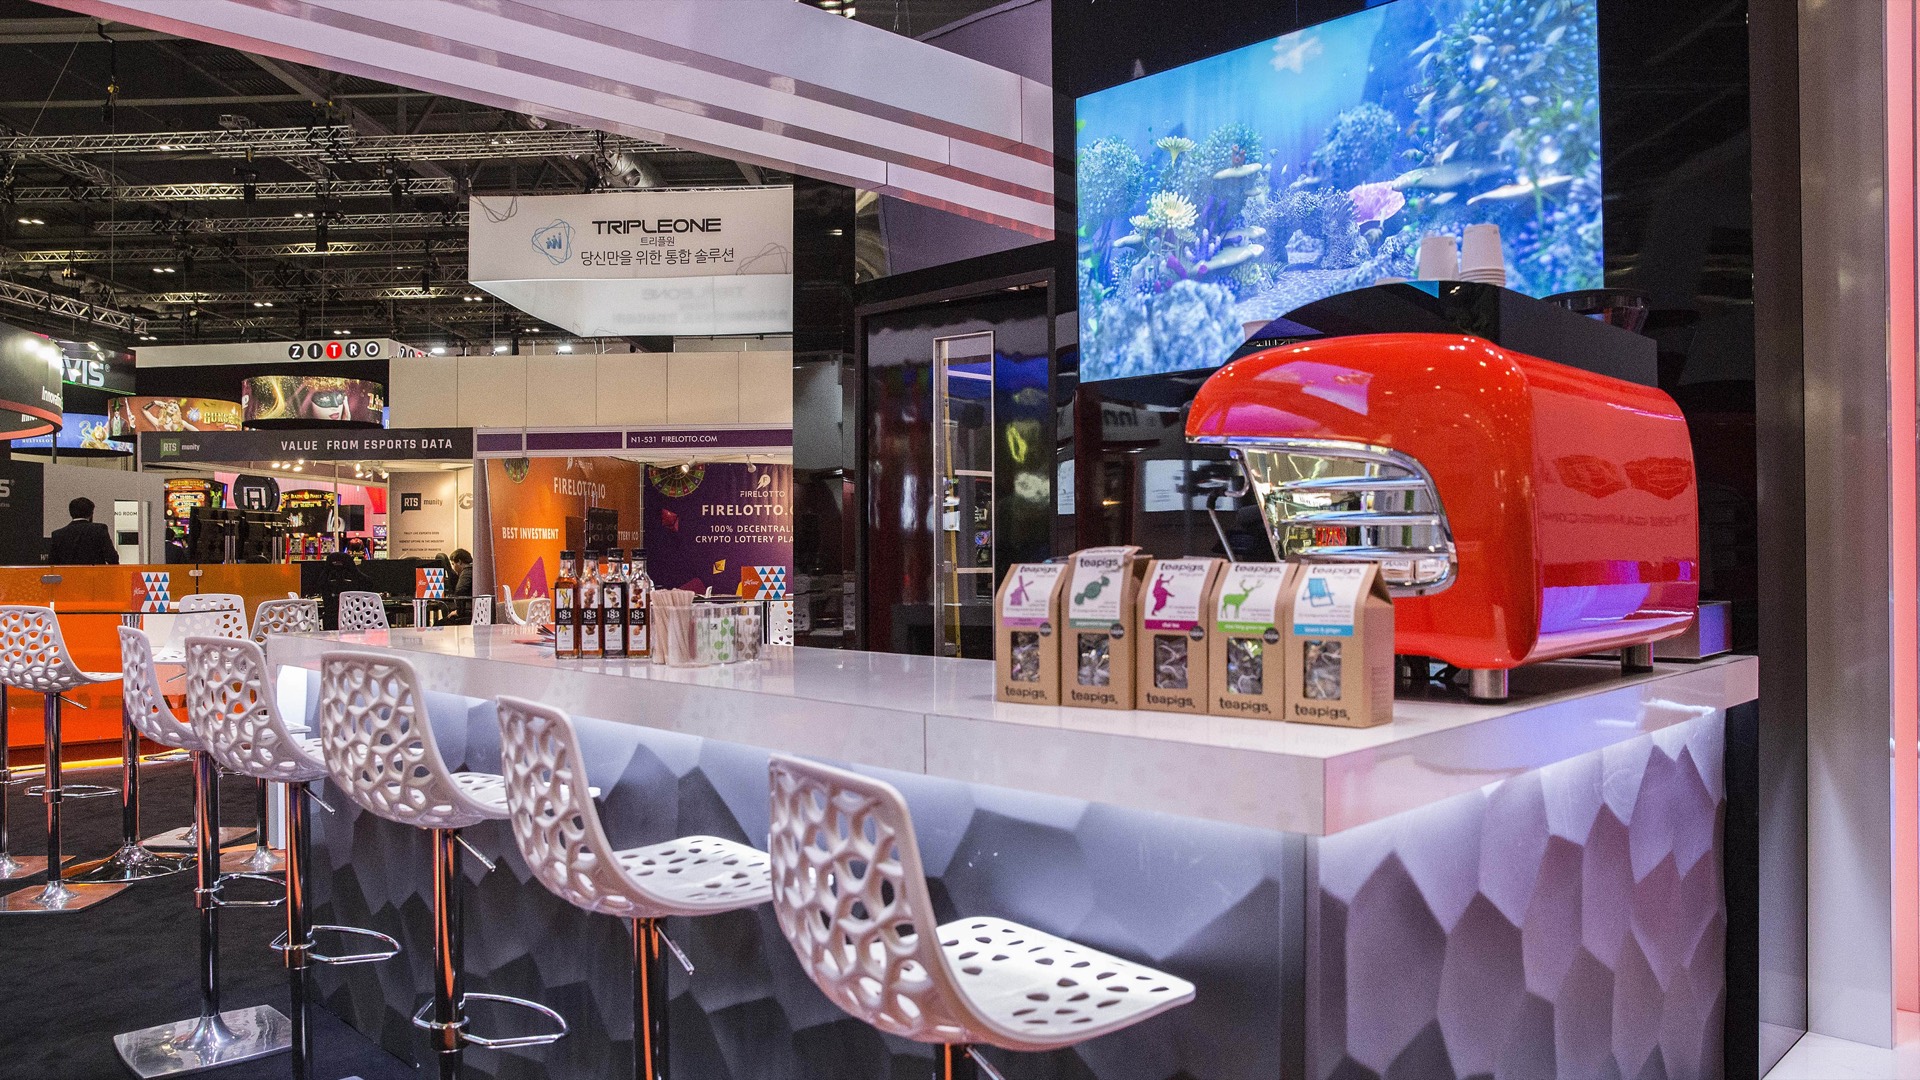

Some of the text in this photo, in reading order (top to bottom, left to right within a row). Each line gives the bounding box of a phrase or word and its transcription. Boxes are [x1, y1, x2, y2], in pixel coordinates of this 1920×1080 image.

[592, 218, 722, 235] TRIPLEONE
[639, 236, 675, 247] 트리플원
[581, 247, 735, 267] 당신만을 위한 통합 솔루션
[289, 341, 380, 359] ZITRO
[661, 435, 718, 443] FIRELOTTO.COM
[163, 442, 177, 452] RTS
[281, 439, 453, 451] VALUE FROM ESPORTS DATA
[739, 490, 786, 498] FIRELOTTO
[403, 497, 419, 507] RTS
[501, 526, 560, 540] BEST INVESTMENT
[710, 525, 734, 533] 100%
[695, 535, 731, 543] CRYPTO
[734, 535, 774, 543] LOTTERY
